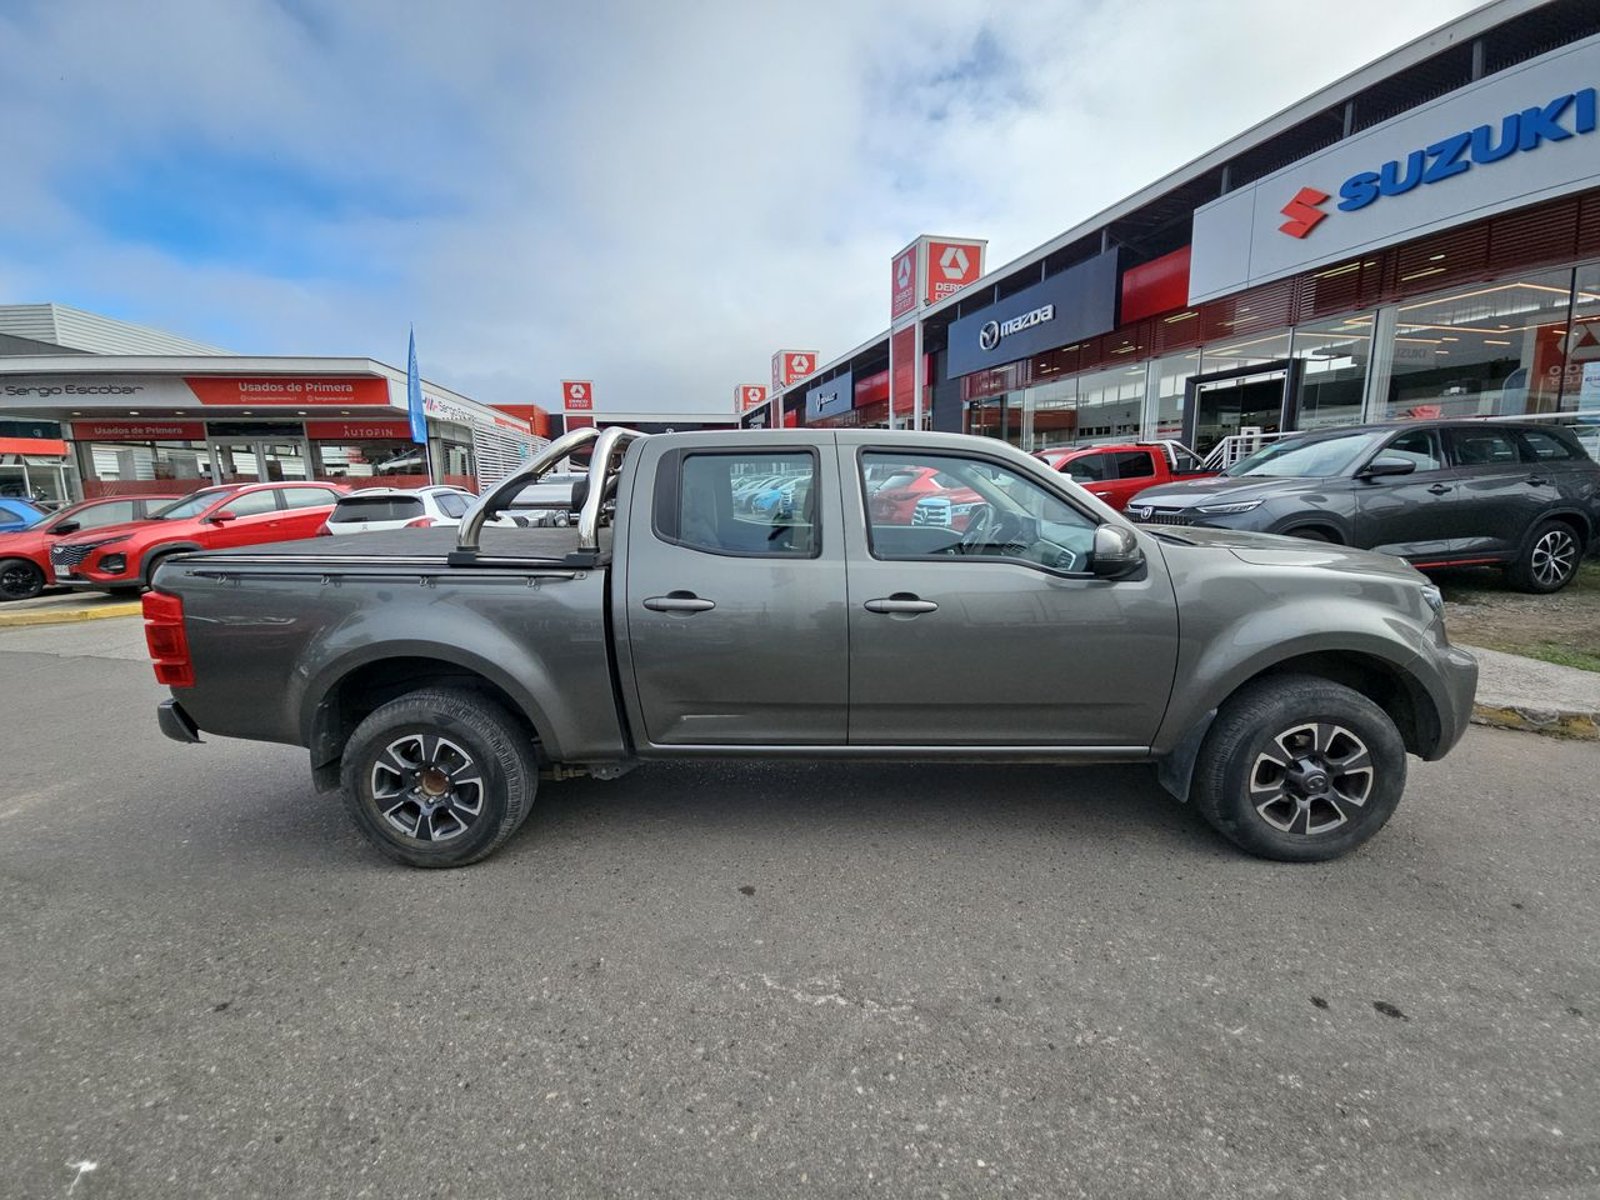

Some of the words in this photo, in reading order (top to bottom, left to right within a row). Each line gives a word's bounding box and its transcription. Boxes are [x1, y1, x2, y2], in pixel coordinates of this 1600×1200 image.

[1337, 87, 1596, 212] SUZUKI
[65, 384, 144, 395] Escobar
[238, 382, 284, 392] Usados
[288, 382, 303, 392] de
[305, 382, 353, 392] Primera
[94, 426, 130, 435] Usados
[132, 426, 144, 435] de
[145, 426, 183, 435] Primera
